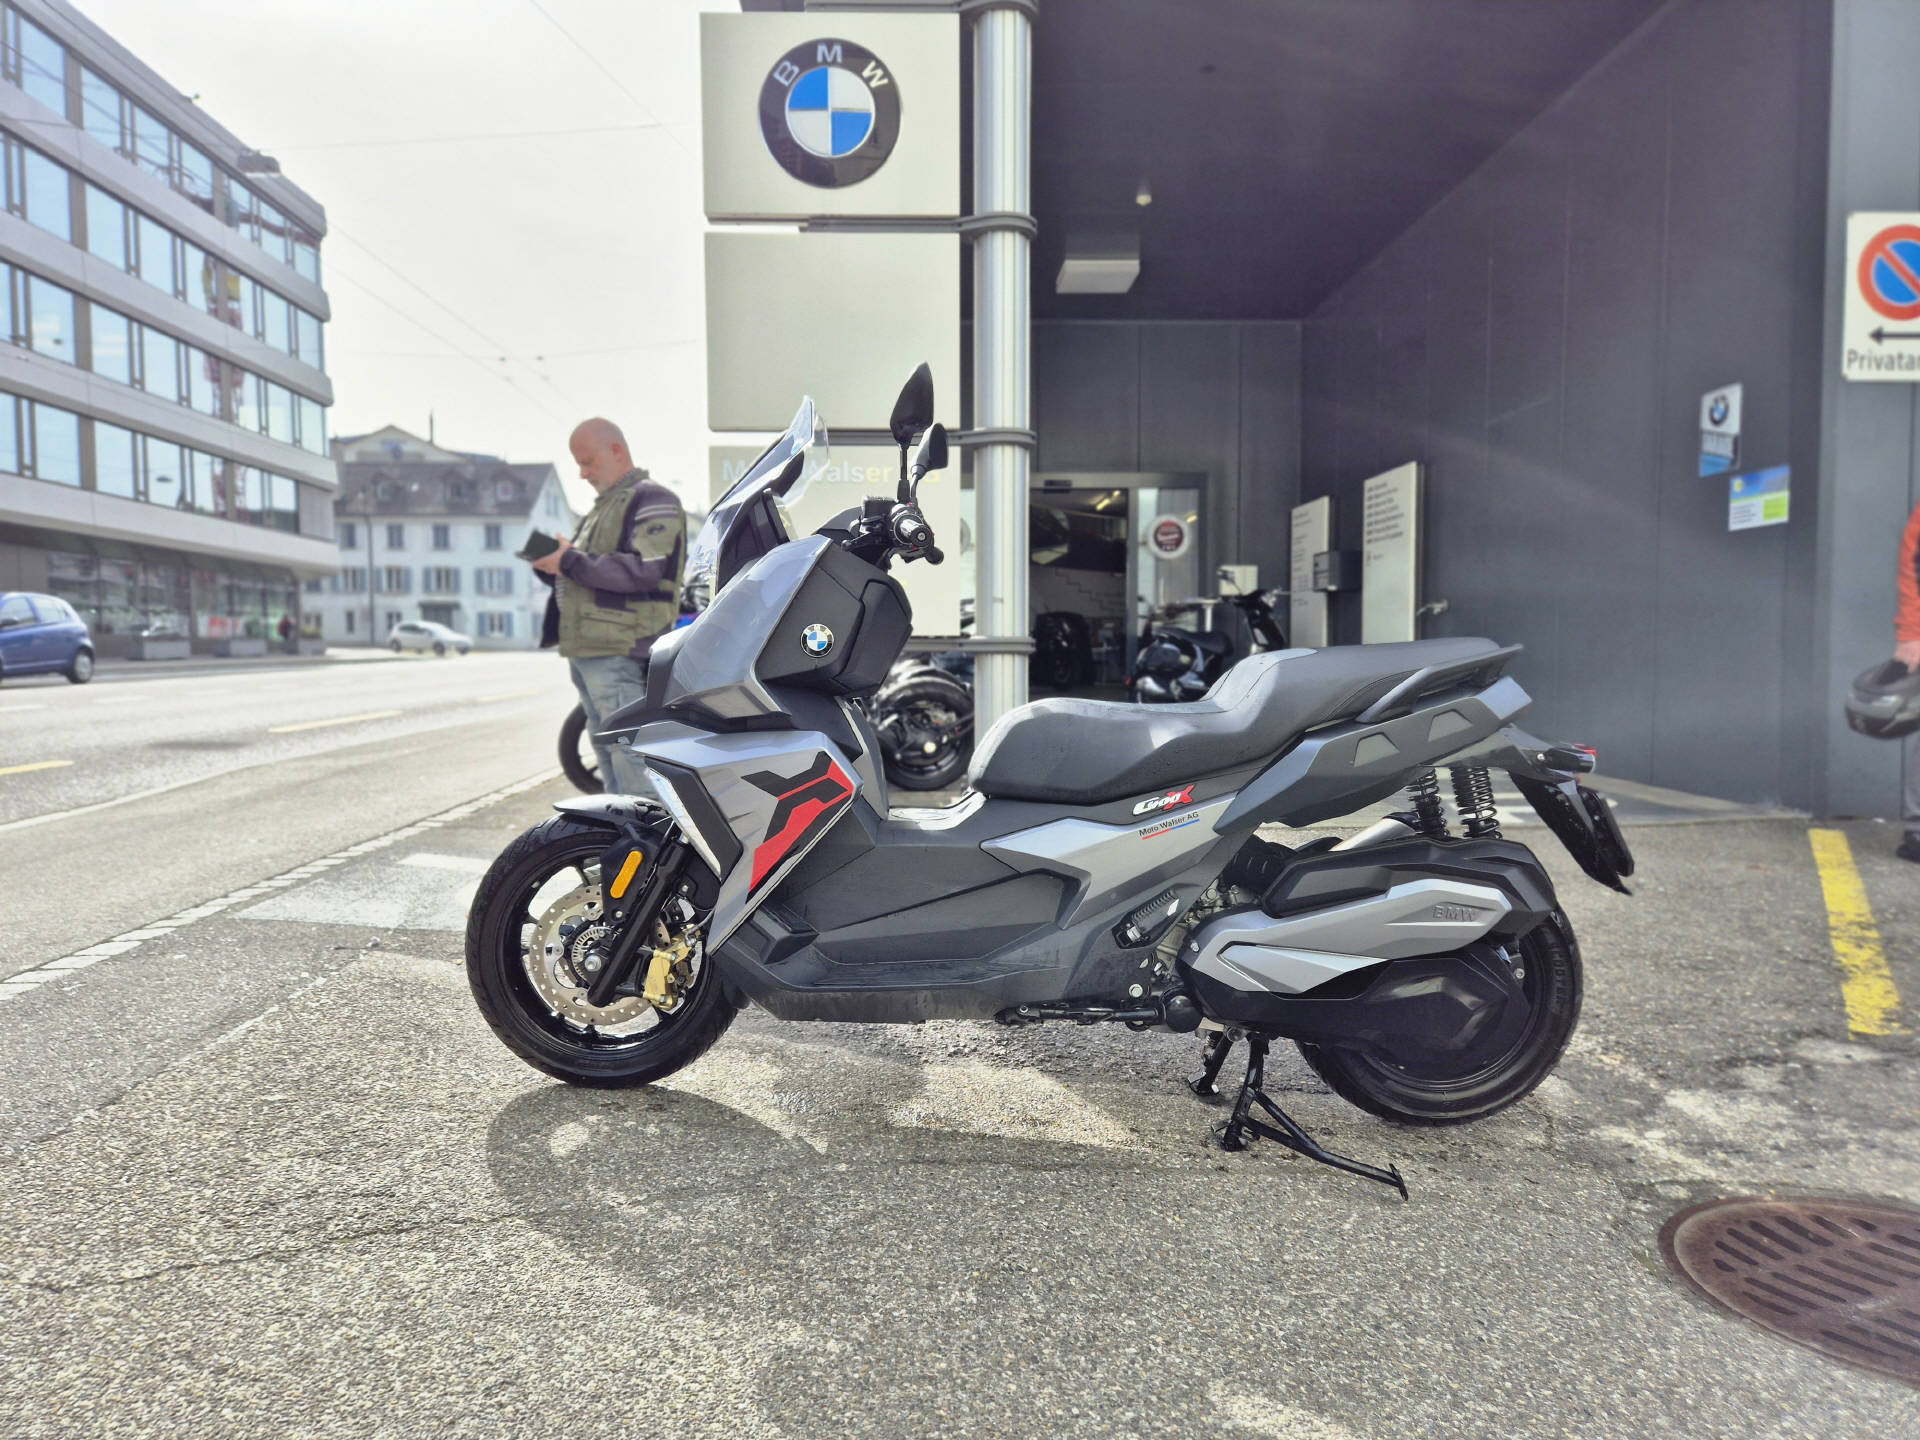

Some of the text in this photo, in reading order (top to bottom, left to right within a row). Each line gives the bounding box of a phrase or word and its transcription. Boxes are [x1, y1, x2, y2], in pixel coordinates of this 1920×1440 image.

[773, 43, 889, 88] BMW
[1139, 811, 1199, 836] Moto Walser AG
[1432, 905, 1478, 920] BMW
